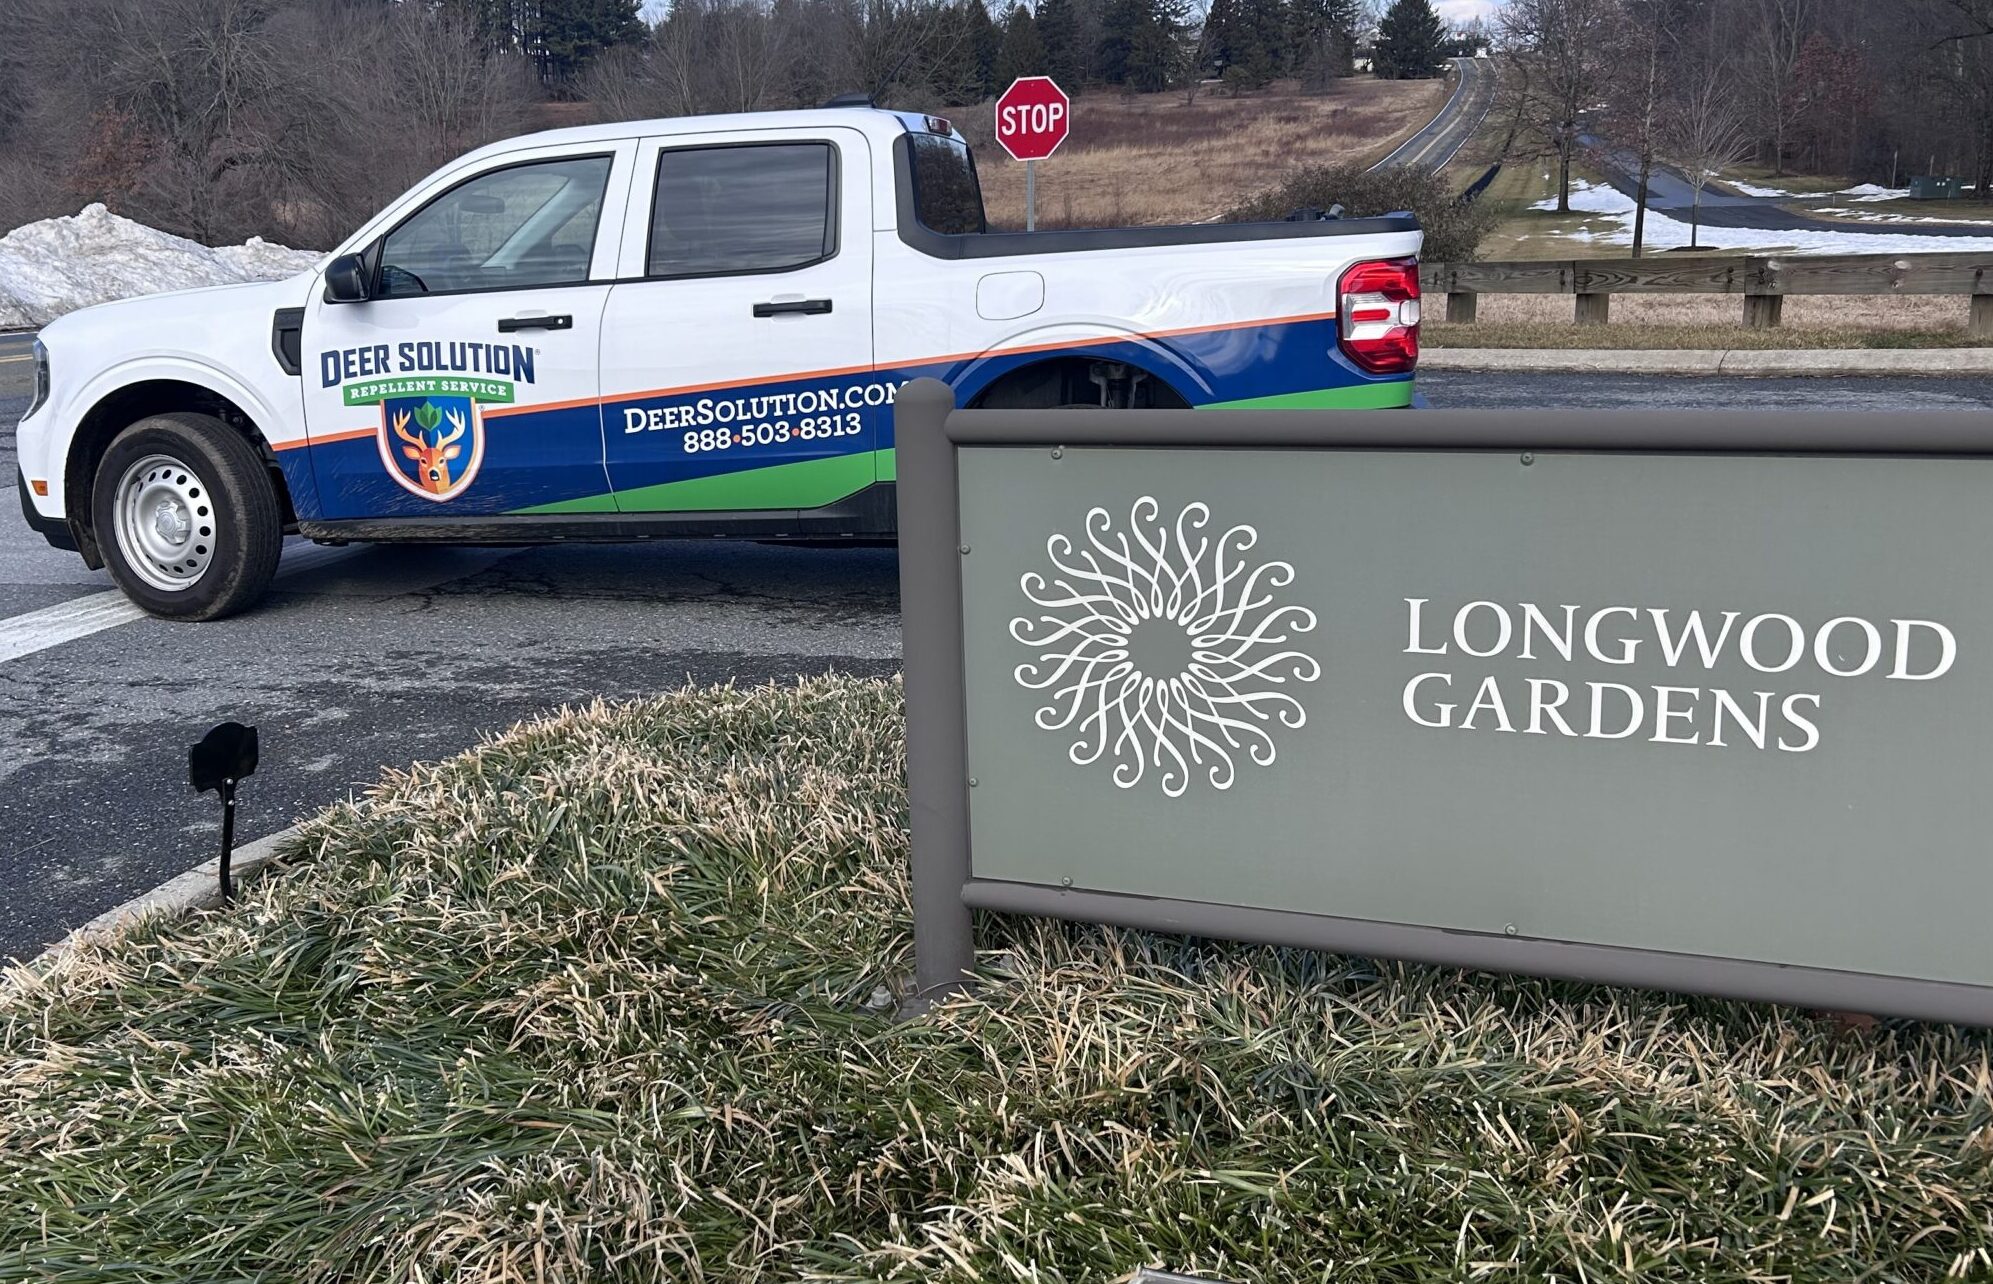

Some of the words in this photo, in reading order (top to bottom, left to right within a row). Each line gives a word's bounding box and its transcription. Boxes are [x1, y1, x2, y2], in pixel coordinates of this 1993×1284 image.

[1001, 102, 1064, 136] STOP
[320, 344, 391, 389] DEER
[350, 380, 436, 399] REPELLENT
[441, 380, 507, 396] SERVICE
[1402, 597, 1957, 681] LONGWOOD
[1402, 672, 1821, 752] GARDENS
